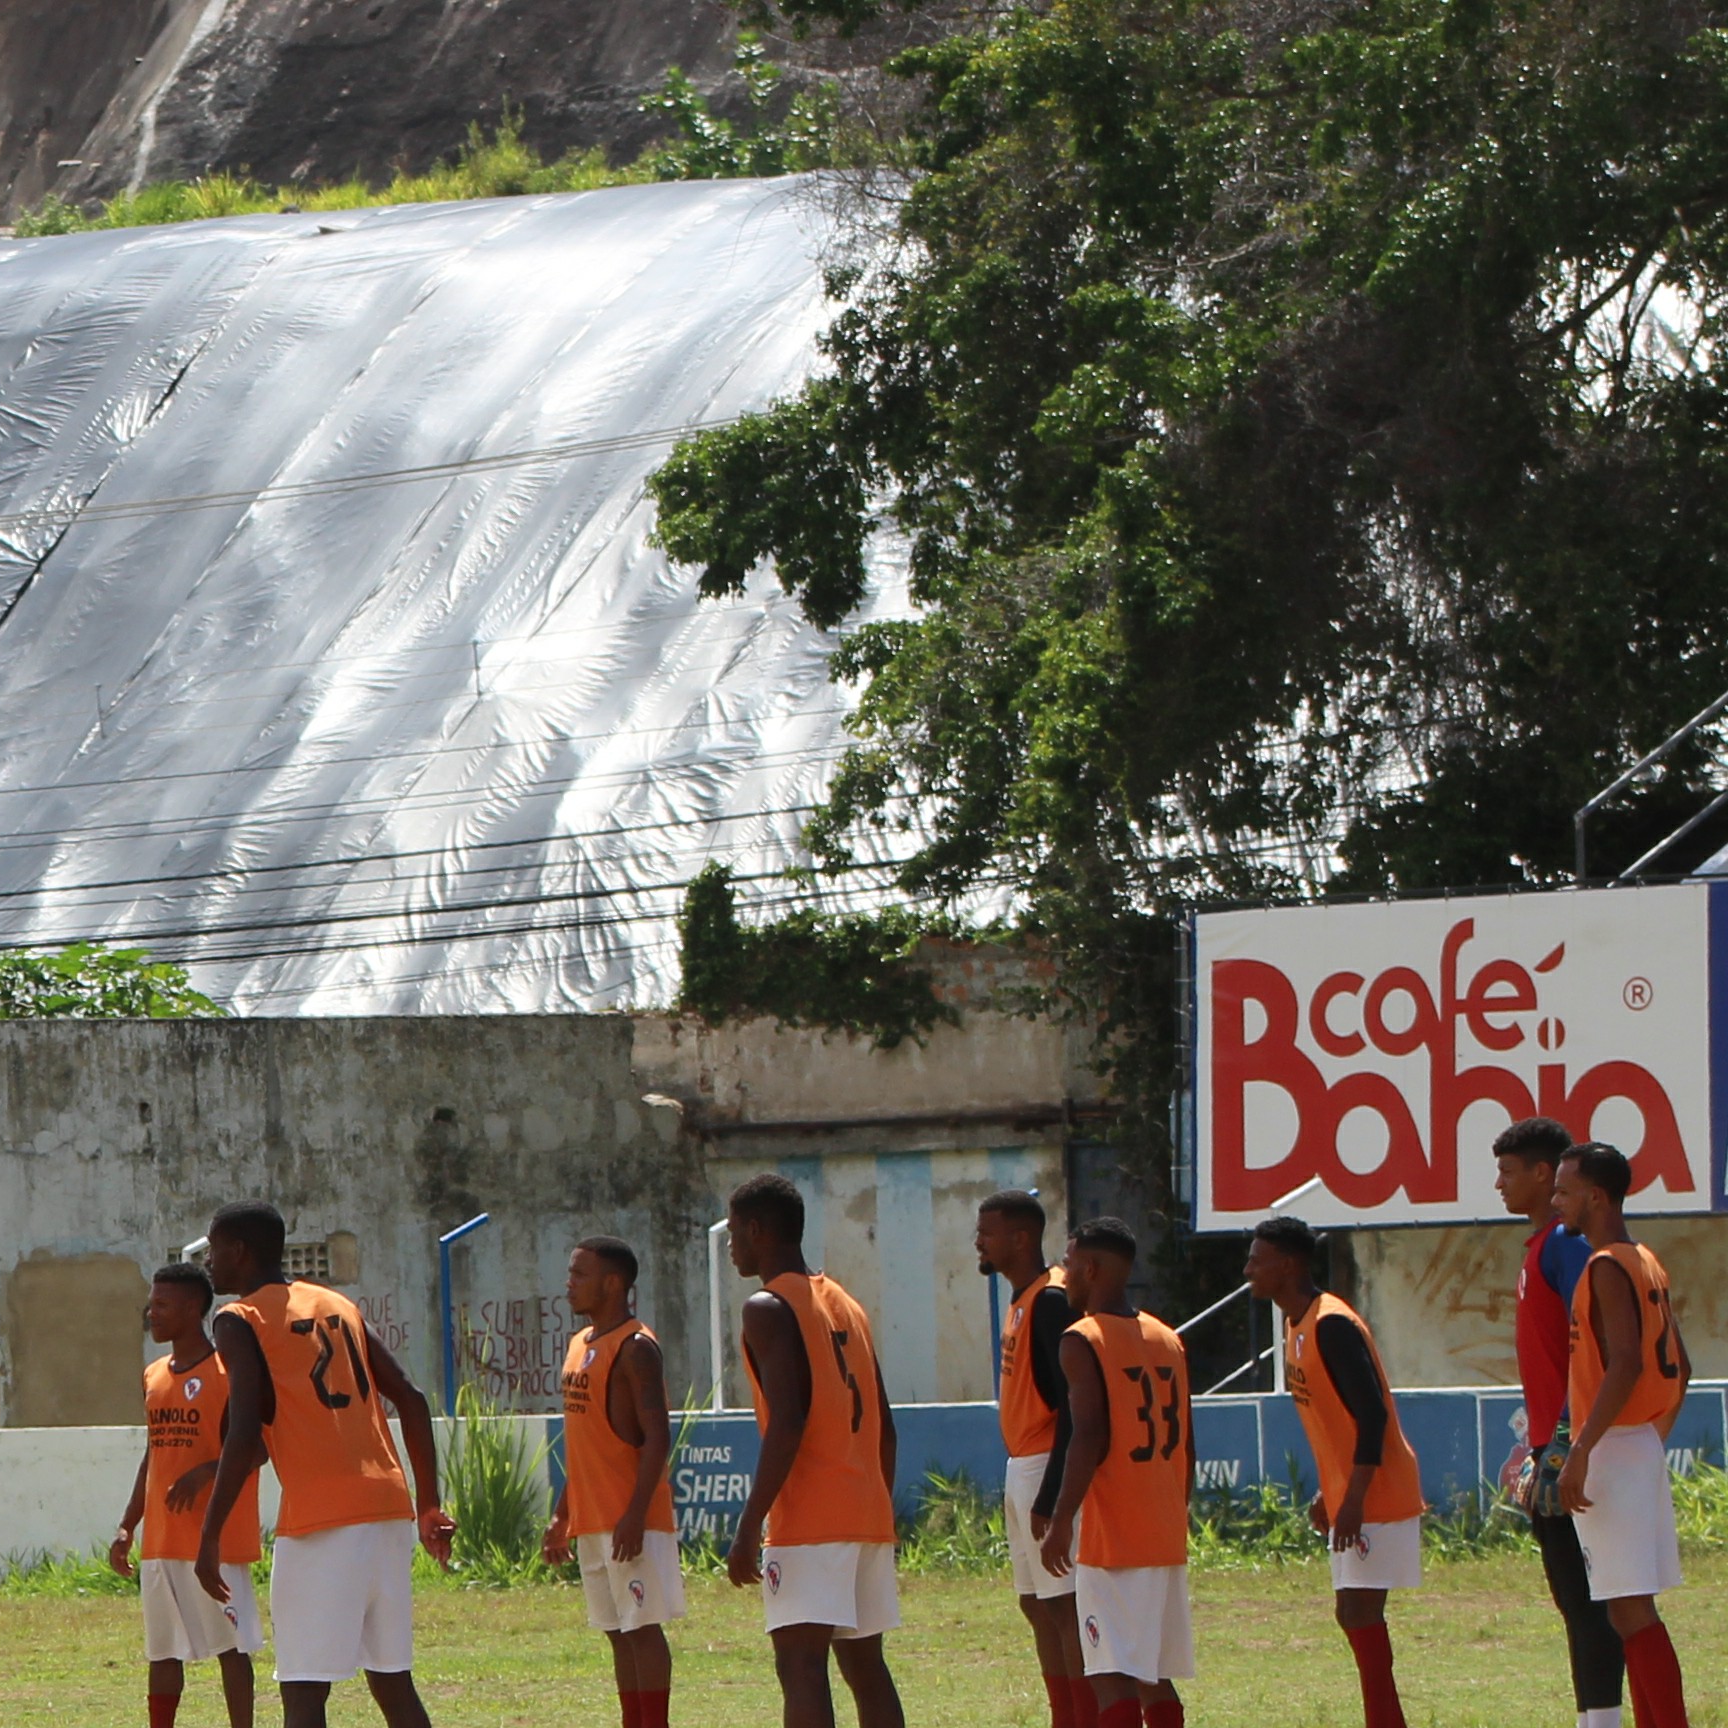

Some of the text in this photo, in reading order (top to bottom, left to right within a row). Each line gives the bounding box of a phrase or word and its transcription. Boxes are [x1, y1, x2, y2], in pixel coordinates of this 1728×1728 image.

[1309, 917, 1565, 1063] café
[1212, 959, 1696, 1212] Bahia
[289, 1314, 370, 1410] 21
[678, 1443, 732, 1465] TINTAS
[1121, 1365, 1181, 1463] 33
